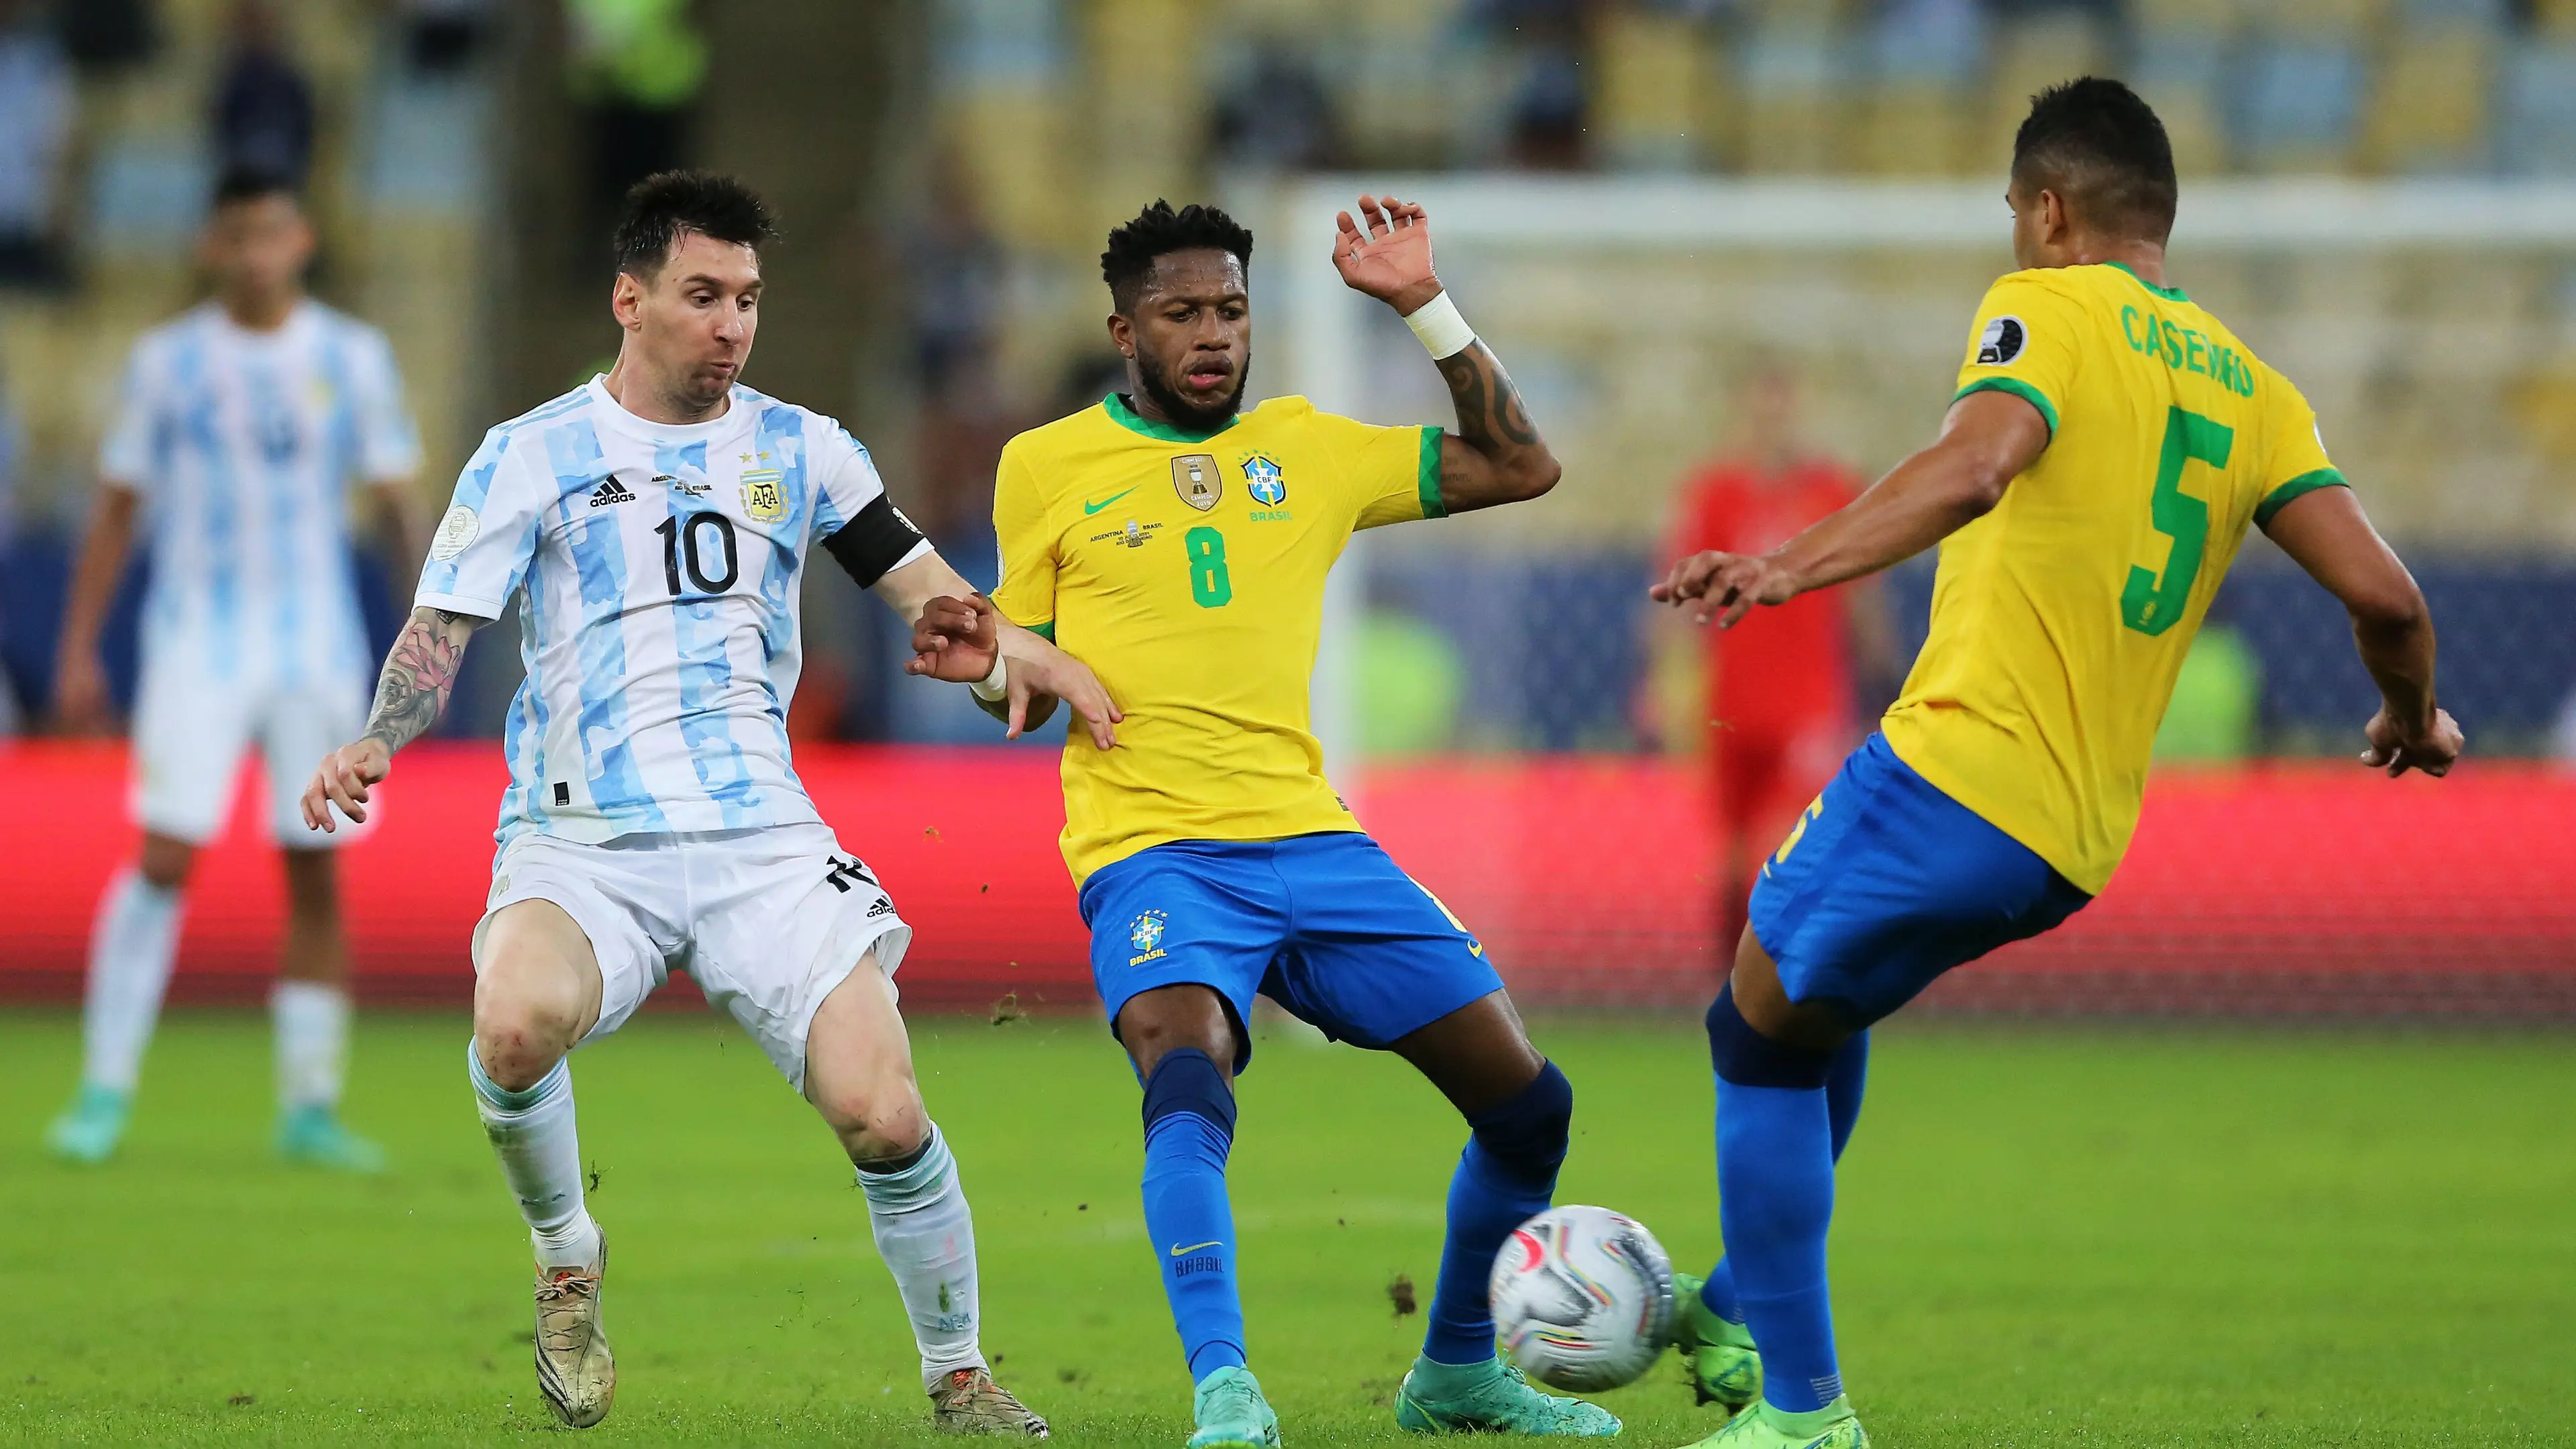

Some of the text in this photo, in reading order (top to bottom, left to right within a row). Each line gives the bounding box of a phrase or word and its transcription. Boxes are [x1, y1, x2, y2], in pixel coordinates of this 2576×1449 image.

[590, 493, 636, 507] adidas
[753, 484, 778, 509] AFA
[1250, 511, 1293, 522] BRASIL
[2120, 405, 2234, 637] 5
[1089, 530, 1124, 543] ARGENTINA
[653, 511, 739, 596] 10
[1185, 526, 1233, 608] 8
[867, 906, 896, 918] adid
[1129, 949, 1167, 967] BRASIL
